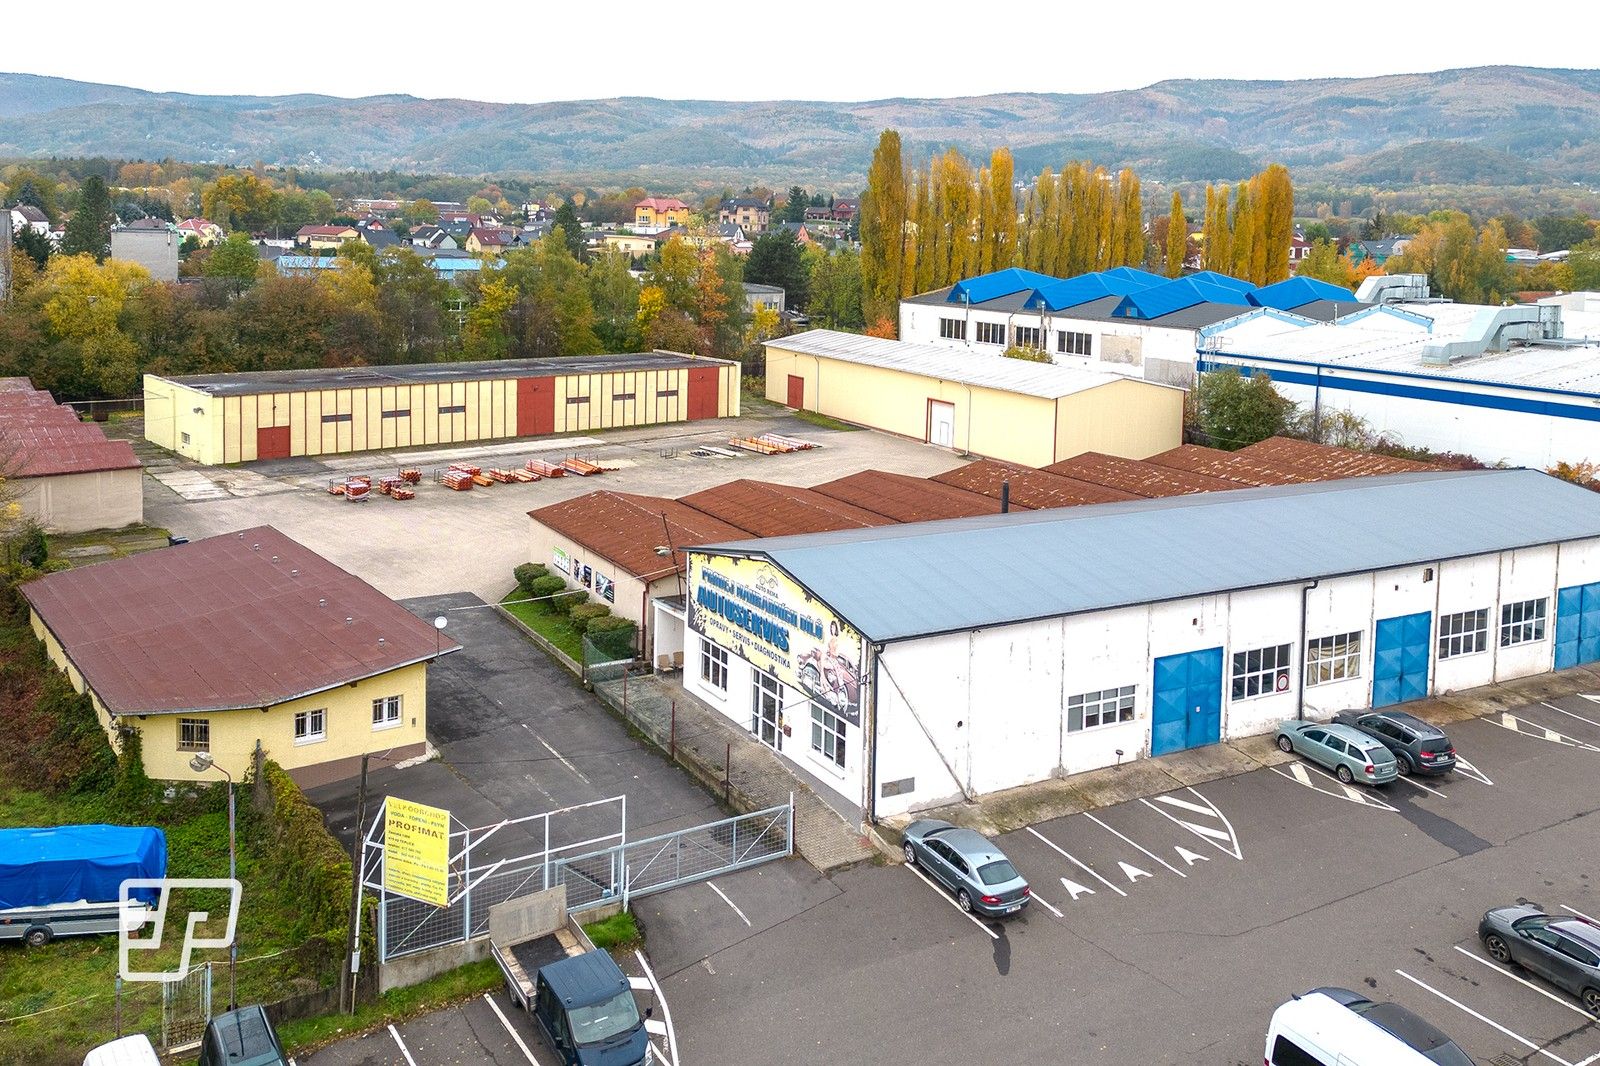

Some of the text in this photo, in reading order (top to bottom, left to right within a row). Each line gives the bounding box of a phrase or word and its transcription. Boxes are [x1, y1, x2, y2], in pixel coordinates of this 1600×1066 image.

[696, 584, 790, 653] AUTOSERVIS
[709, 617, 791, 669] OPRAVY SERVIS DIAGNOSTIKA
[388, 819, 446, 840] PROFIMAT
